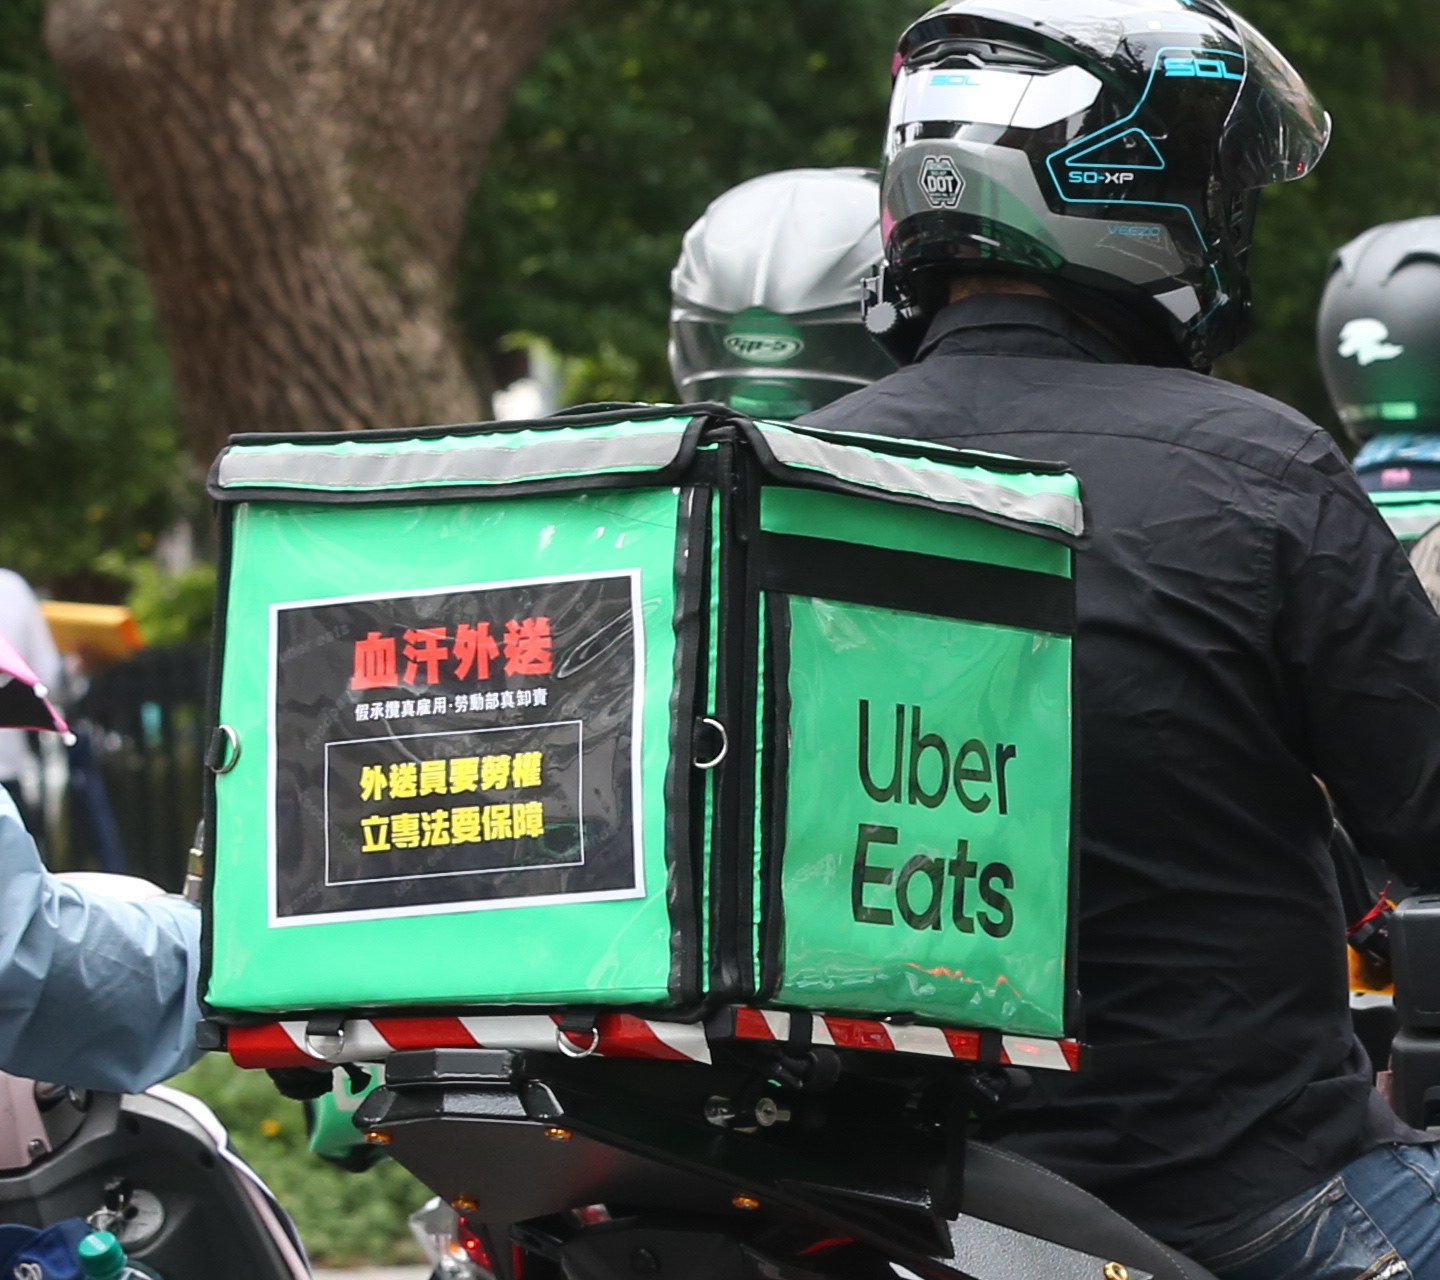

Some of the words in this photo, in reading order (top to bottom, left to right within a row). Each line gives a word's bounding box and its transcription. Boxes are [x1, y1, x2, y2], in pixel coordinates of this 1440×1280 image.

[929, 74, 980, 87] SOL
[1163, 57, 1243, 81] SOL
[927, 175, 954, 193] DOT
[351, 617, 553, 690] 血汗外送
[359, 751, 543, 801] 外送員要勞權
[855, 698, 1017, 818] Uber
[360, 801, 545, 853] 立專法要保障
[851, 824, 1016, 938] Eats
